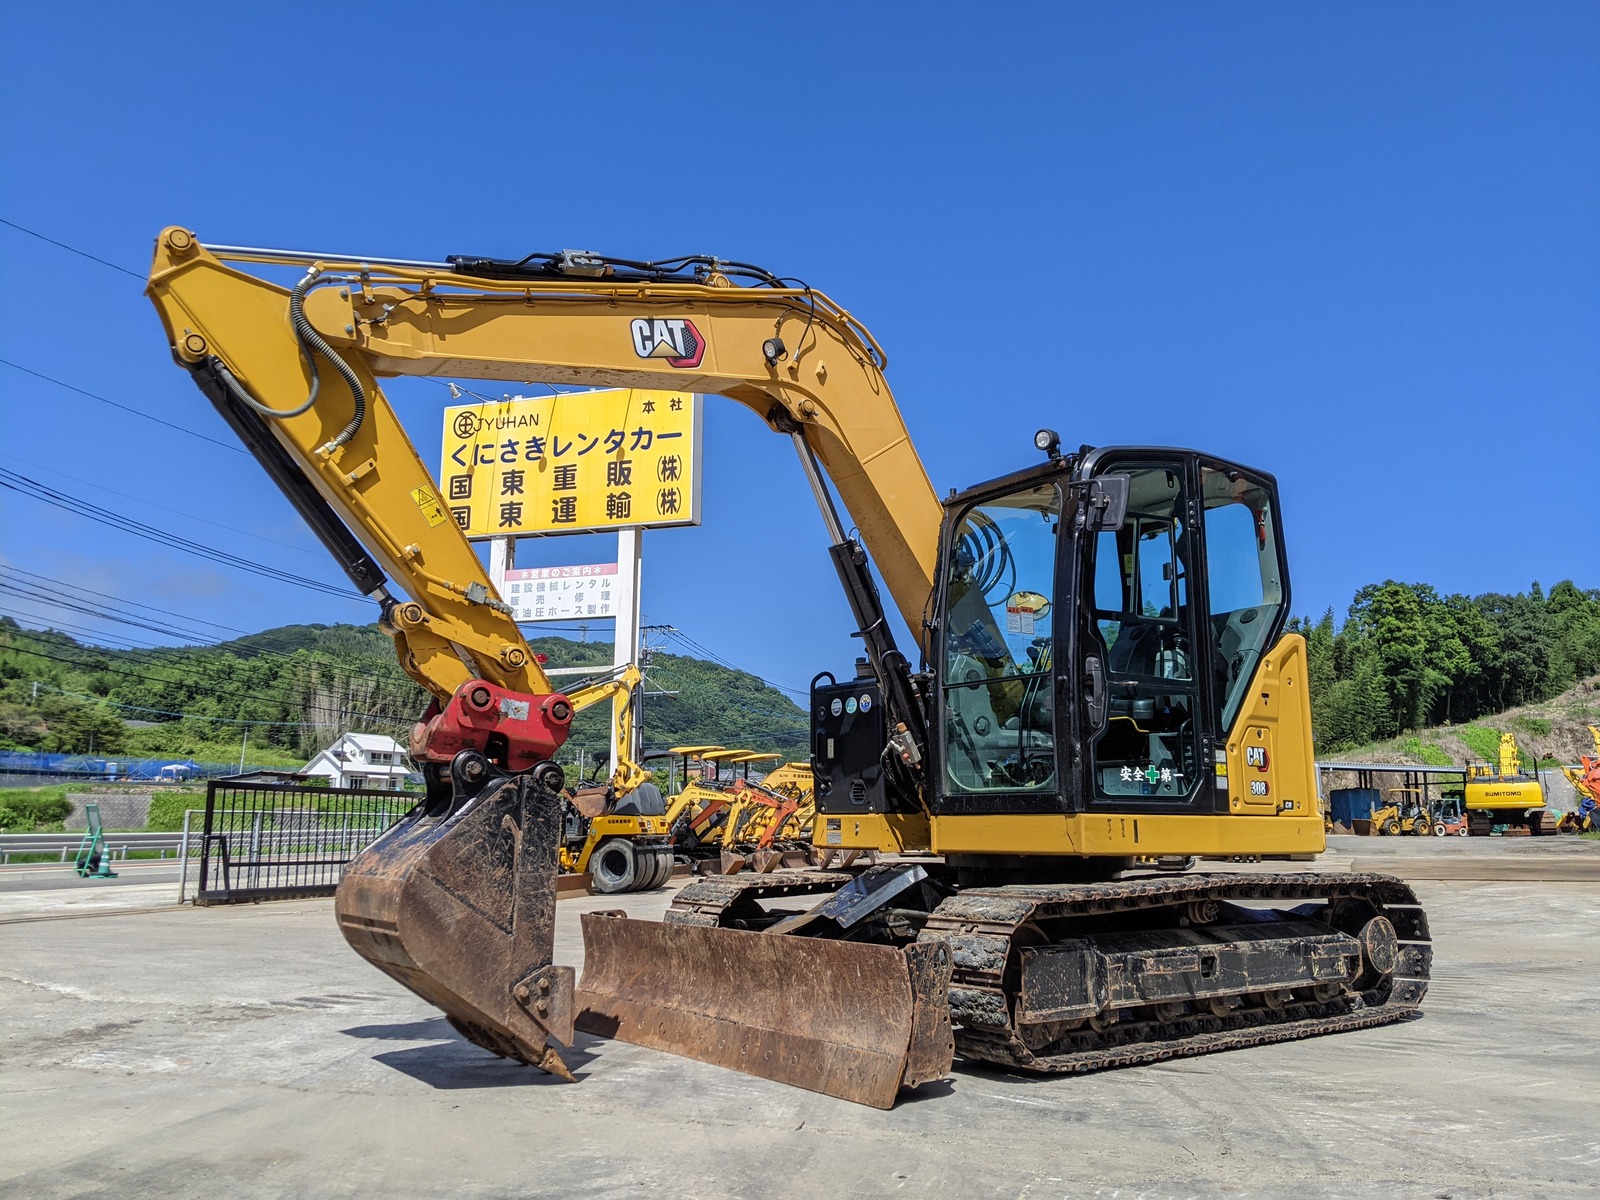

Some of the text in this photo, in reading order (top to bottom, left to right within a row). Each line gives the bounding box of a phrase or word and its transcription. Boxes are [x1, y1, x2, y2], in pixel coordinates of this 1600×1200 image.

[631, 319, 686, 357] CAT
[452, 426, 682, 467] くにさきレンタカー
[510, 578, 611, 594] 建設機械レンタル
[1246, 746, 1265, 767] CAT
[1250, 781, 1266, 796] 308
